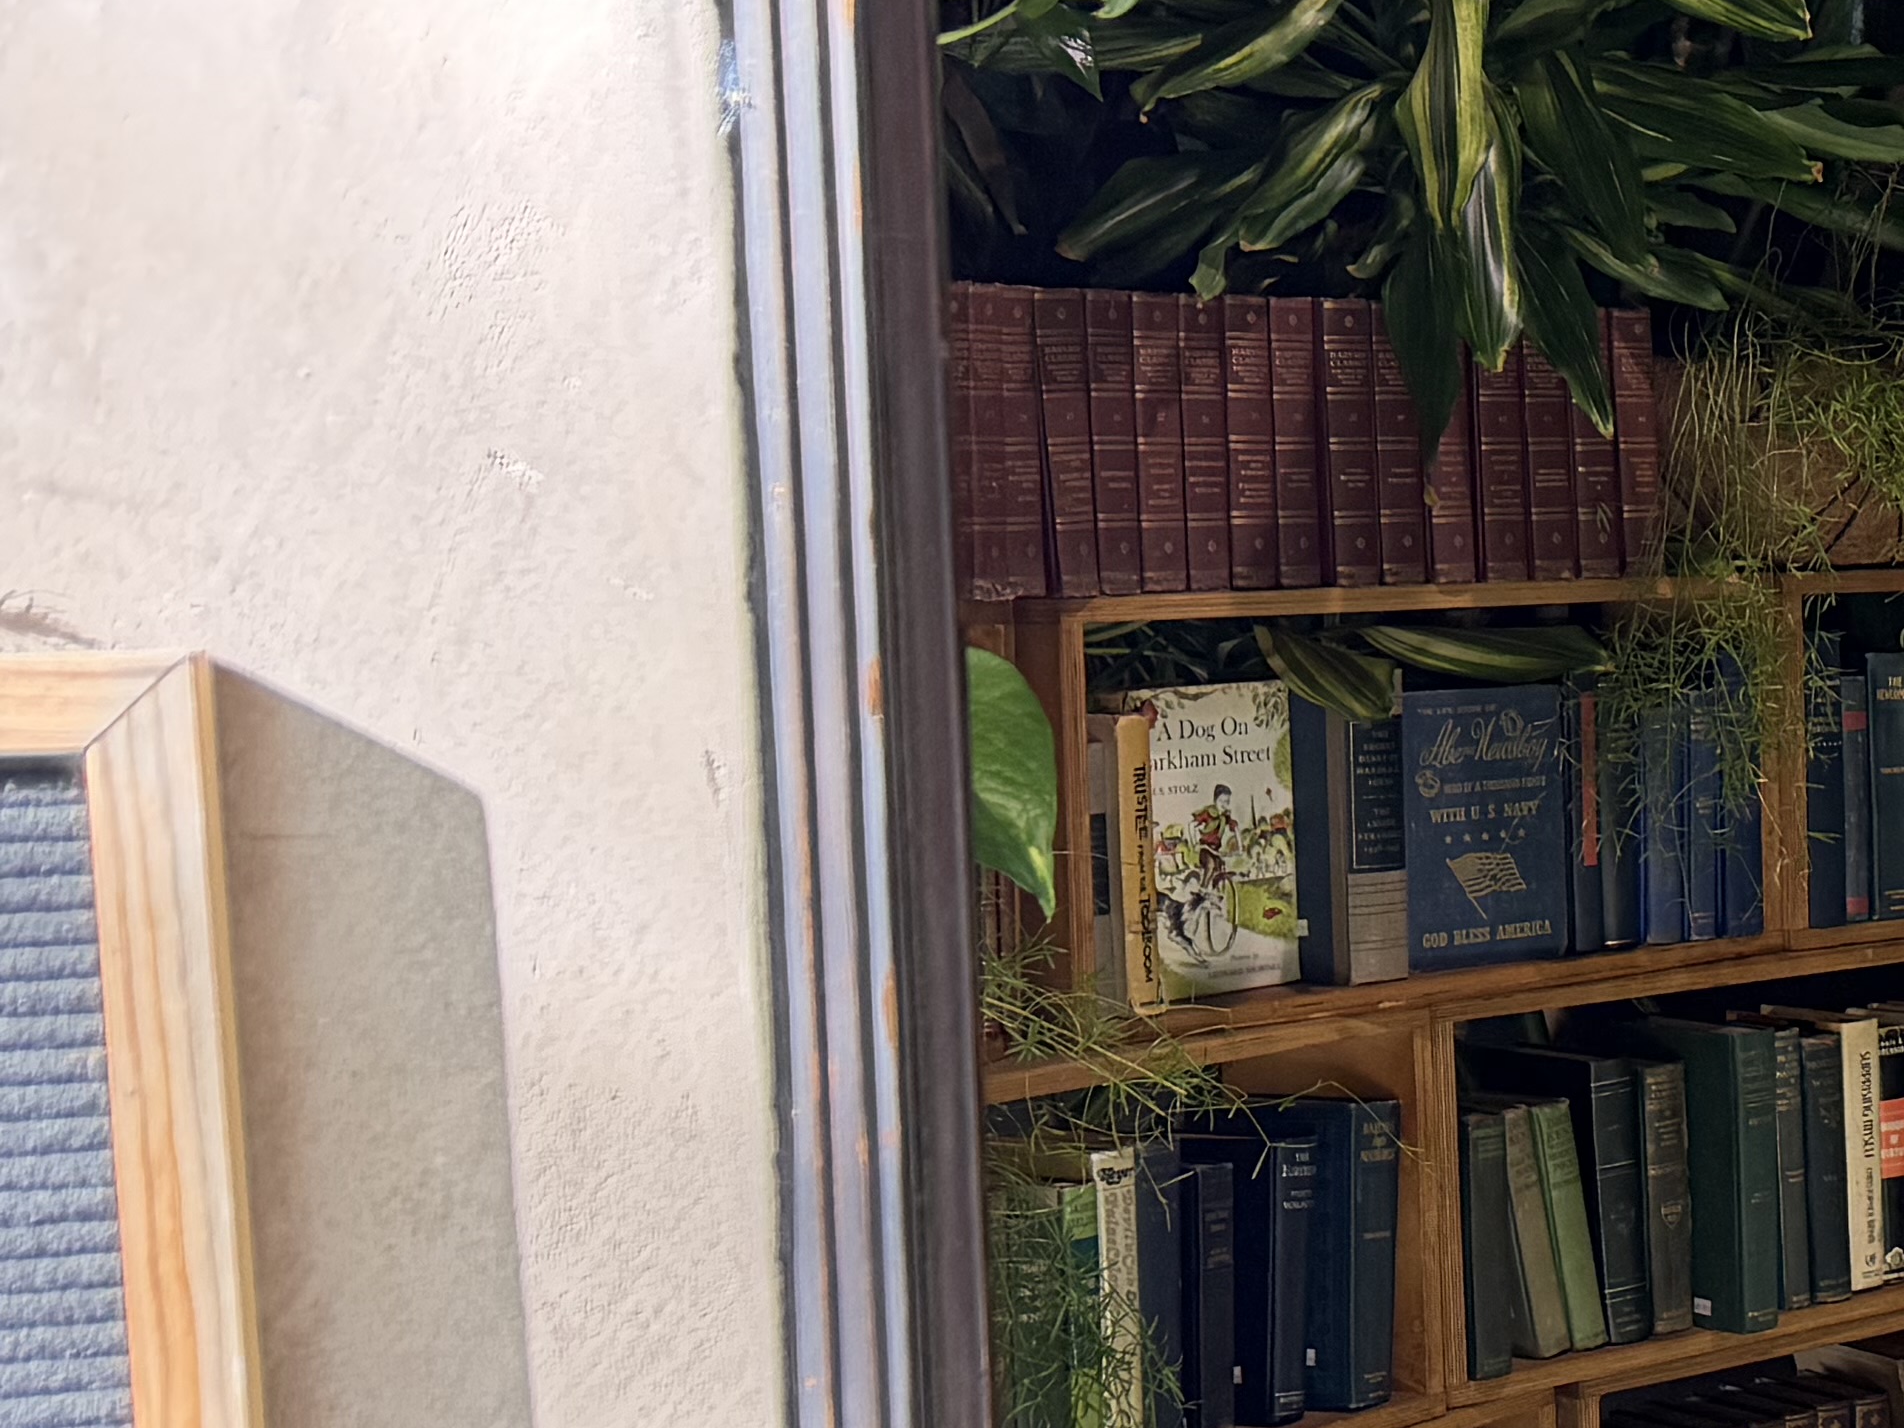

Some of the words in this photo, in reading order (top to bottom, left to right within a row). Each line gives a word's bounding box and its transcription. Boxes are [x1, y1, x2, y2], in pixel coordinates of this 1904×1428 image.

[1156, 721, 1172, 742] A
[1179, 718, 1216, 743] Dog
[1221, 716, 1249, 737] On
[1150, 748, 1217, 772] arkham
[1222, 744, 1271, 766] Street
[1133, 763, 1149, 841] TRUSTEE
[1168, 784, 1200, 795] STOLZ
[1429, 807, 1467, 824] WITH
[1470, 805, 1480, 820] U
[1487, 803, 1497, 819] S
[1503, 799, 1541, 817] NAVY
[1422, 932, 1449, 949] GOD
[1453, 927, 1491, 946] BLESS
[1496, 919, 1553, 941] AMERICA
[1859, 1051, 1874, 1118] SURPRISING
